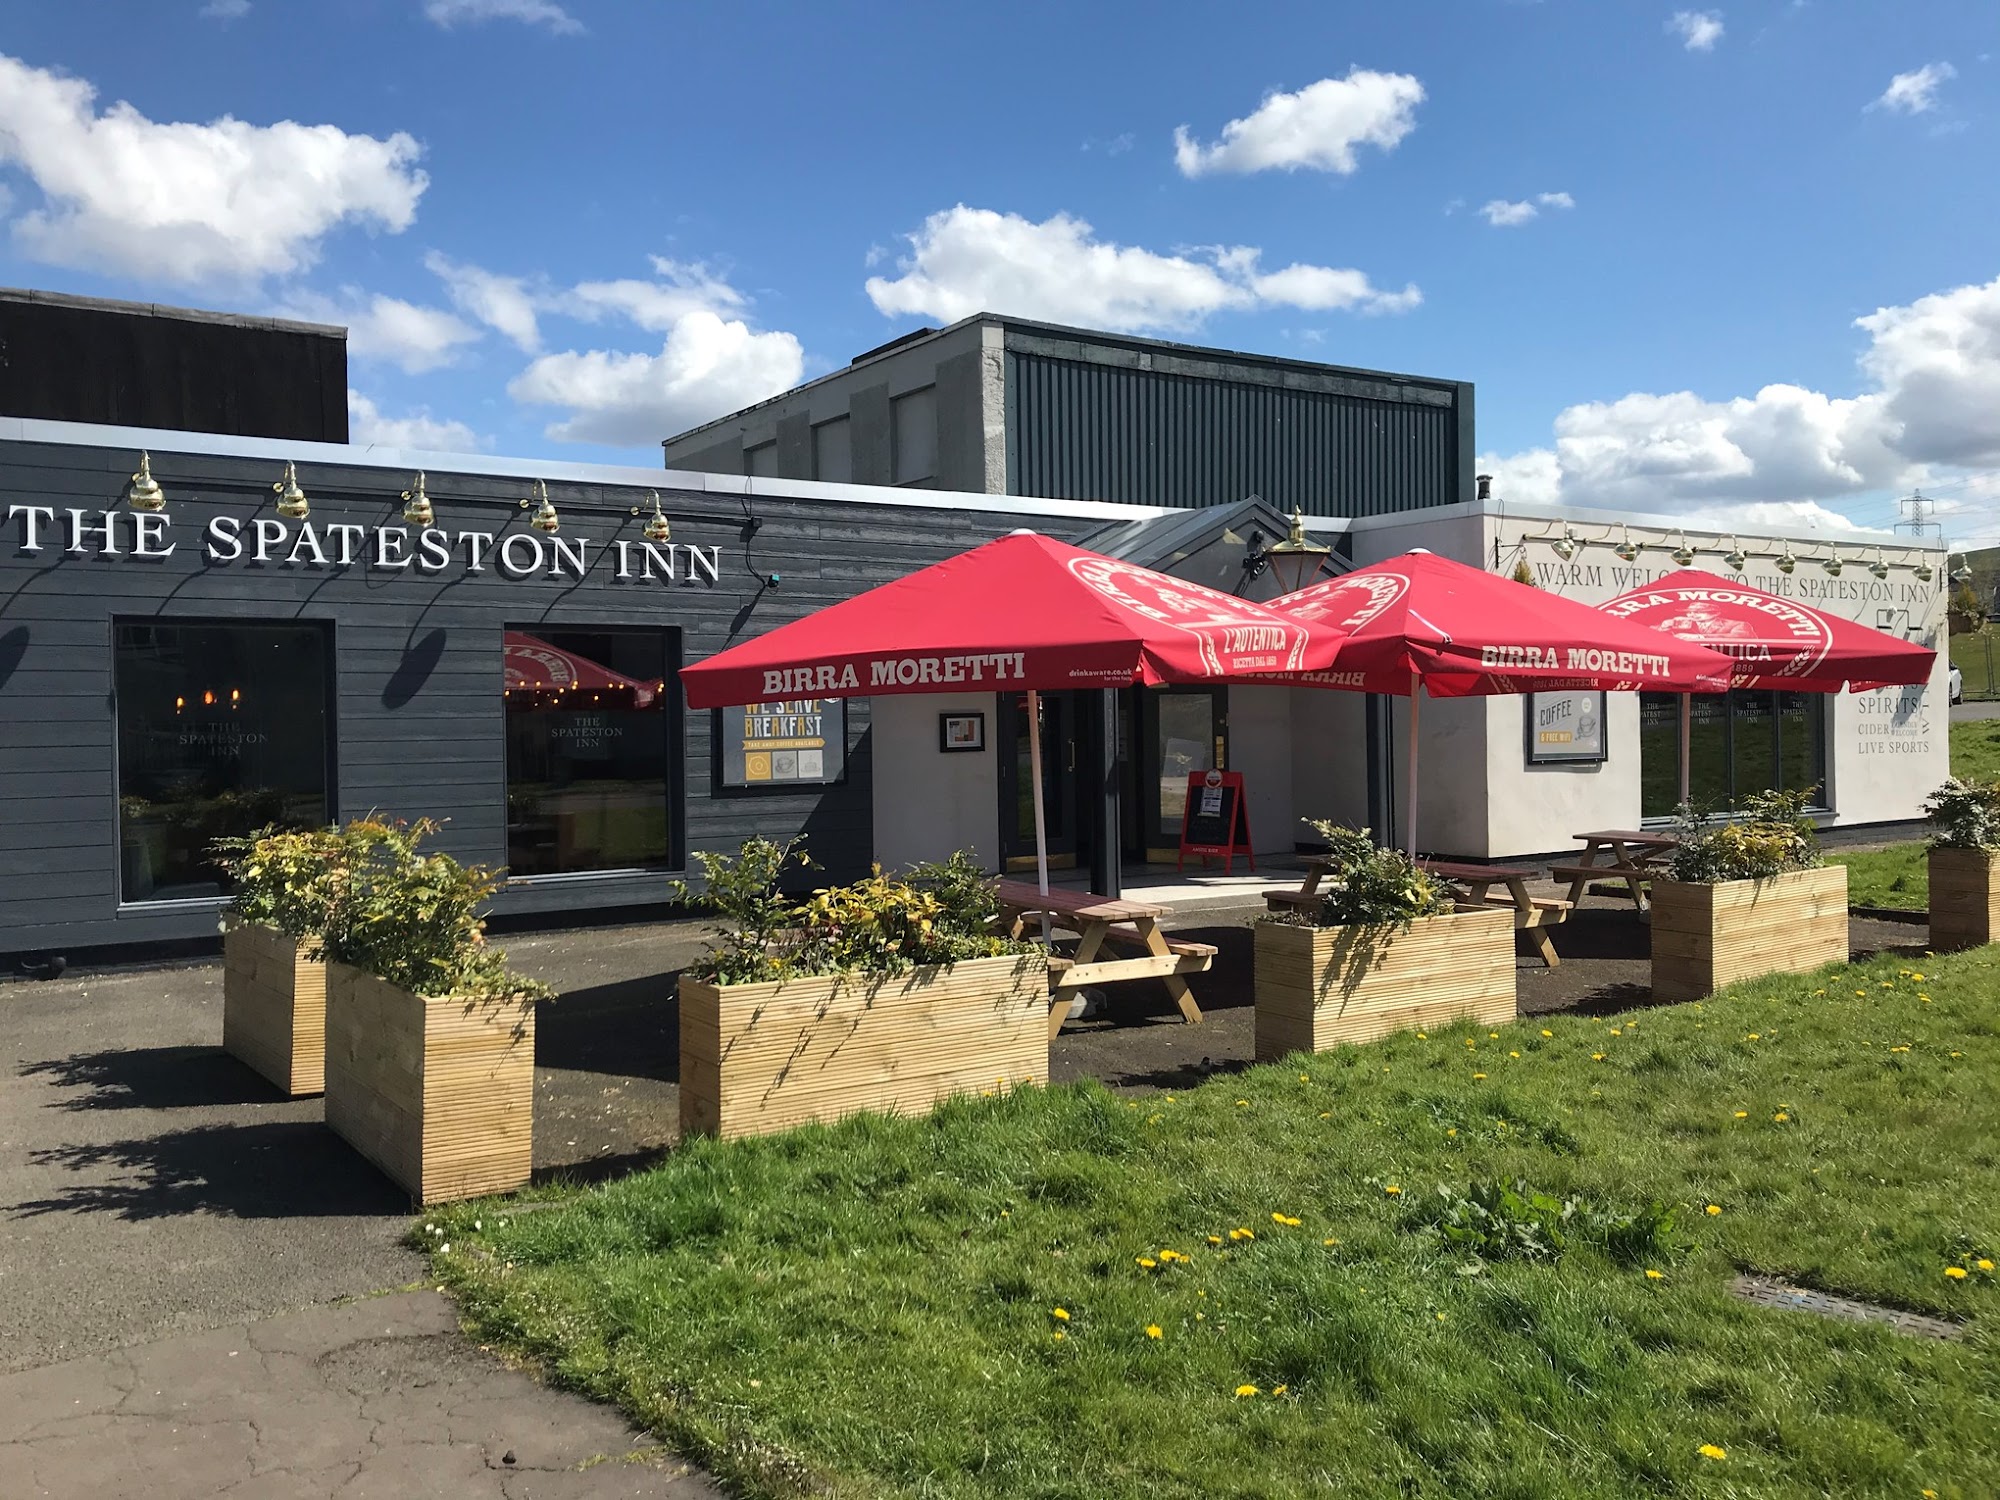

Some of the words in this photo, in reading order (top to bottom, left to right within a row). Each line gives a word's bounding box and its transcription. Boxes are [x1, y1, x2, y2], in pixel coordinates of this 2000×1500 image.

[8, 504, 177, 557] THE
[207, 514, 591, 576] SPATESTON
[615, 540, 723, 582] INN
[1535, 562, 1603, 587] WARM
[1755, 575, 1793, 596] THE
[1799, 577, 1894, 601] SPATESTON
[1900, 584, 1930, 603] INN
[1336, 577, 1399, 626] MORETTI
[1677, 591, 1821, 637] MORETTI
[1221, 626, 1287, 655] L'AUTENTICA
[1481, 645, 1559, 670] BIRRA
[1567, 648, 1671, 677] MORETTI
[762, 664, 859, 694] BIRRA
[870, 652, 1025, 686] MORETTI
[1069, 668, 1132, 677] drinkaware.co.uk
[1540, 700, 1572, 727] COFFEE
[1858, 697, 1918, 714] SPIRITS
[551, 727, 623, 737] SPATESTON
[574, 717, 600, 726] THE
[745, 716, 822, 738] BREAKFAST
[1857, 723, 1890, 735] CIDER
[179, 733, 269, 745] SPATESTON
[576, 738, 600, 747] INN
[1858, 742, 1885, 755] LIVE
[1888, 740, 1930, 753] SPORTS
